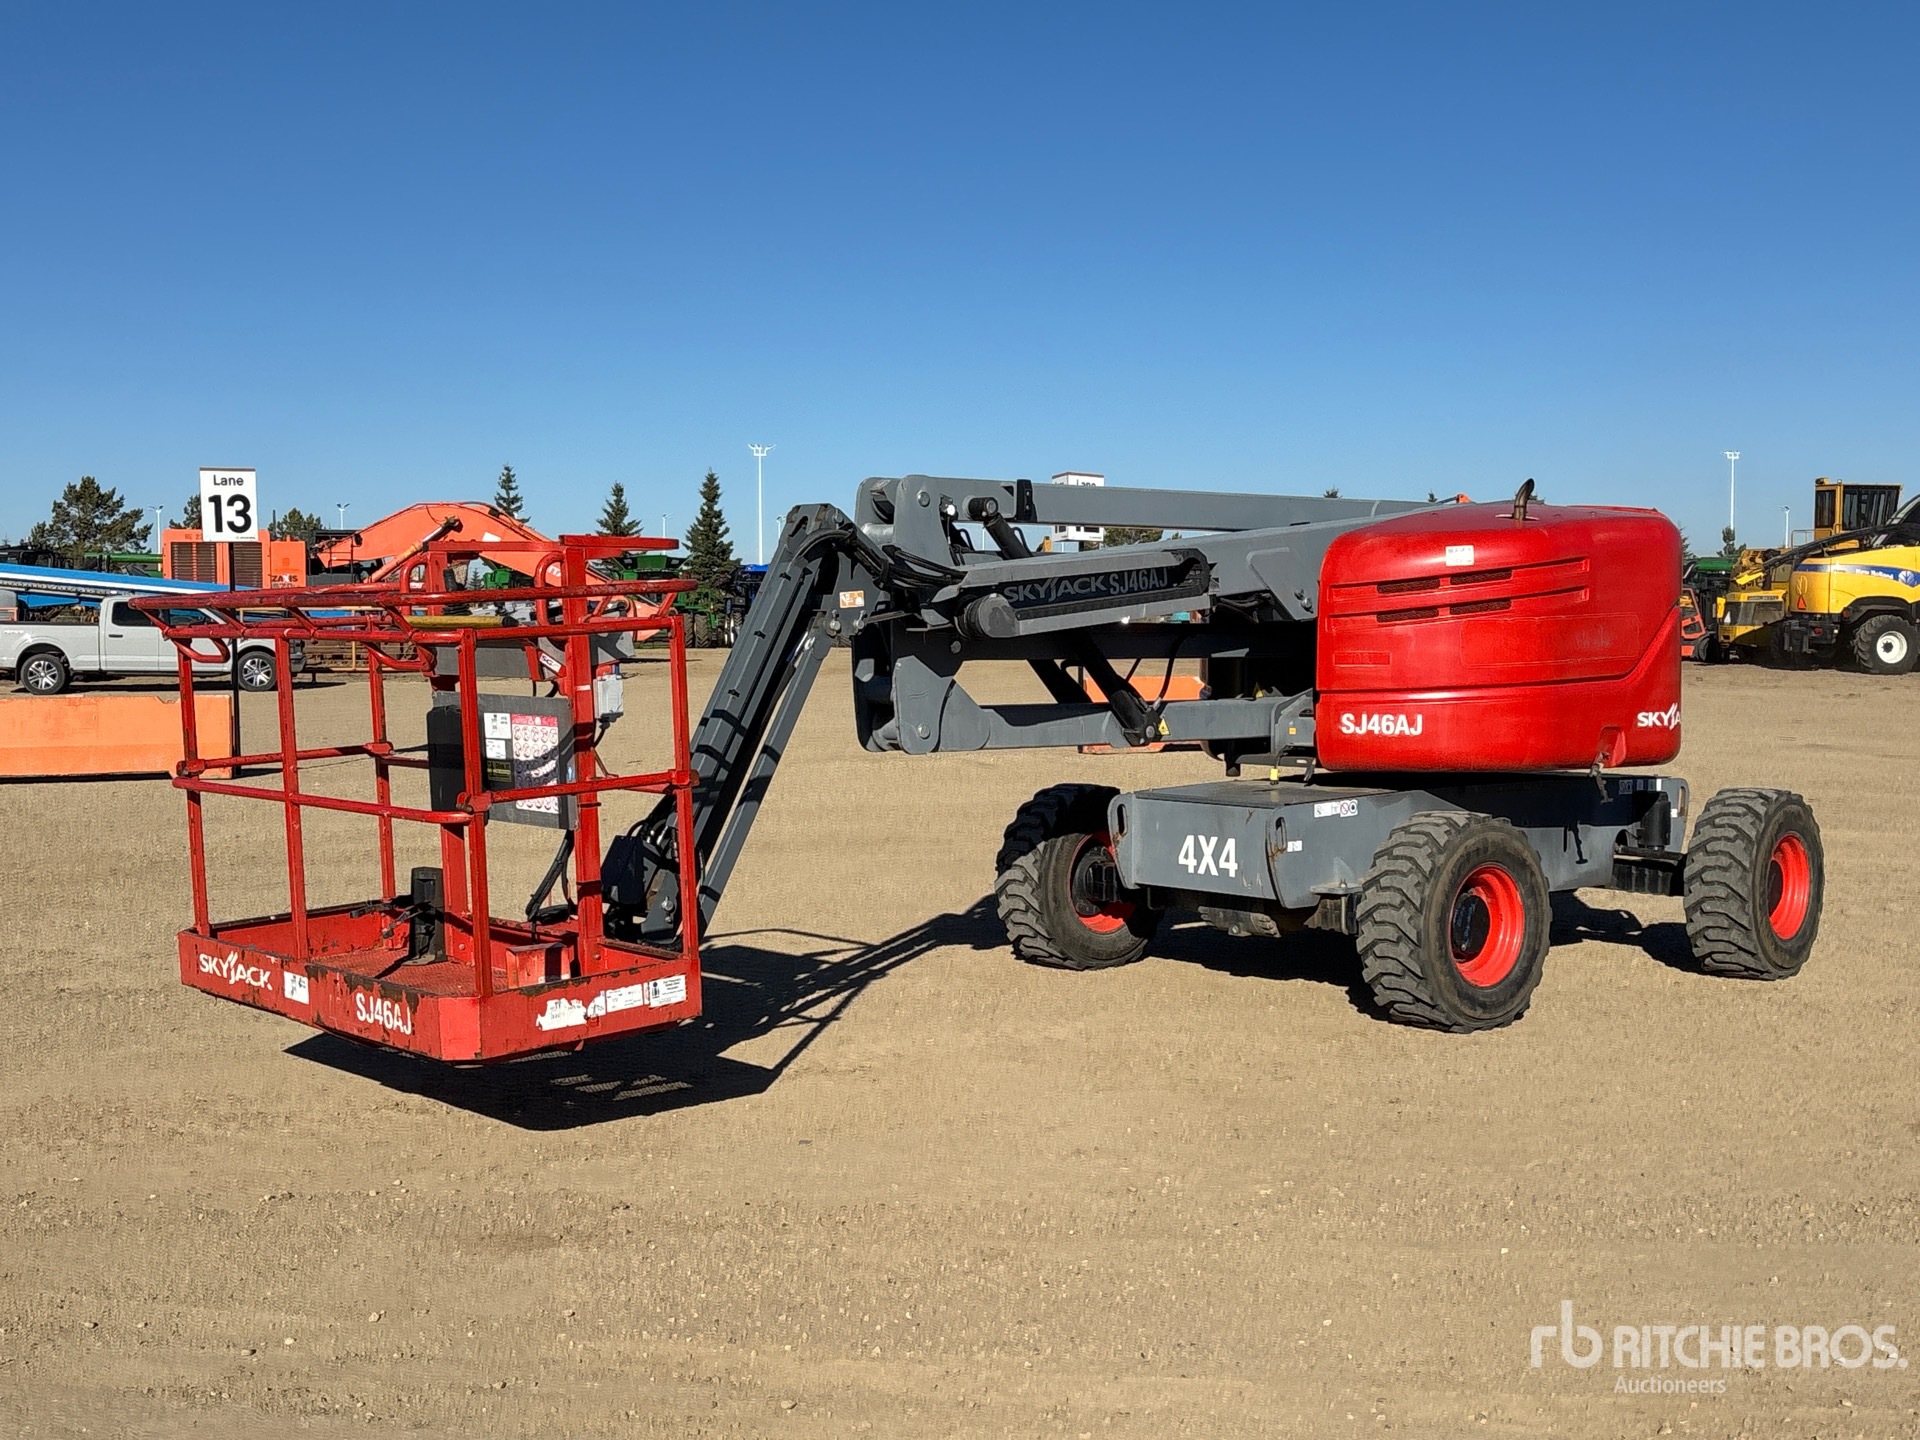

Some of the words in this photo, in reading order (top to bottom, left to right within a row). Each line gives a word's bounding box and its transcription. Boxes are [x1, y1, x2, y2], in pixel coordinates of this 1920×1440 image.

[213, 474, 244, 486] Lane
[208, 494, 252, 533] 13
[271, 573, 299, 583] ZAXIS
[1003, 575, 1106, 602] SKYJACK
[1109, 568, 1168, 595] SJ46AJ
[1341, 713, 1423, 736] SJ46AJ
[1637, 702, 1681, 730] SKYJA
[1178, 835, 1238, 877] 4X4
[199, 951, 273, 991] SKYJACK
[355, 992, 412, 1035] SJ46AJ
